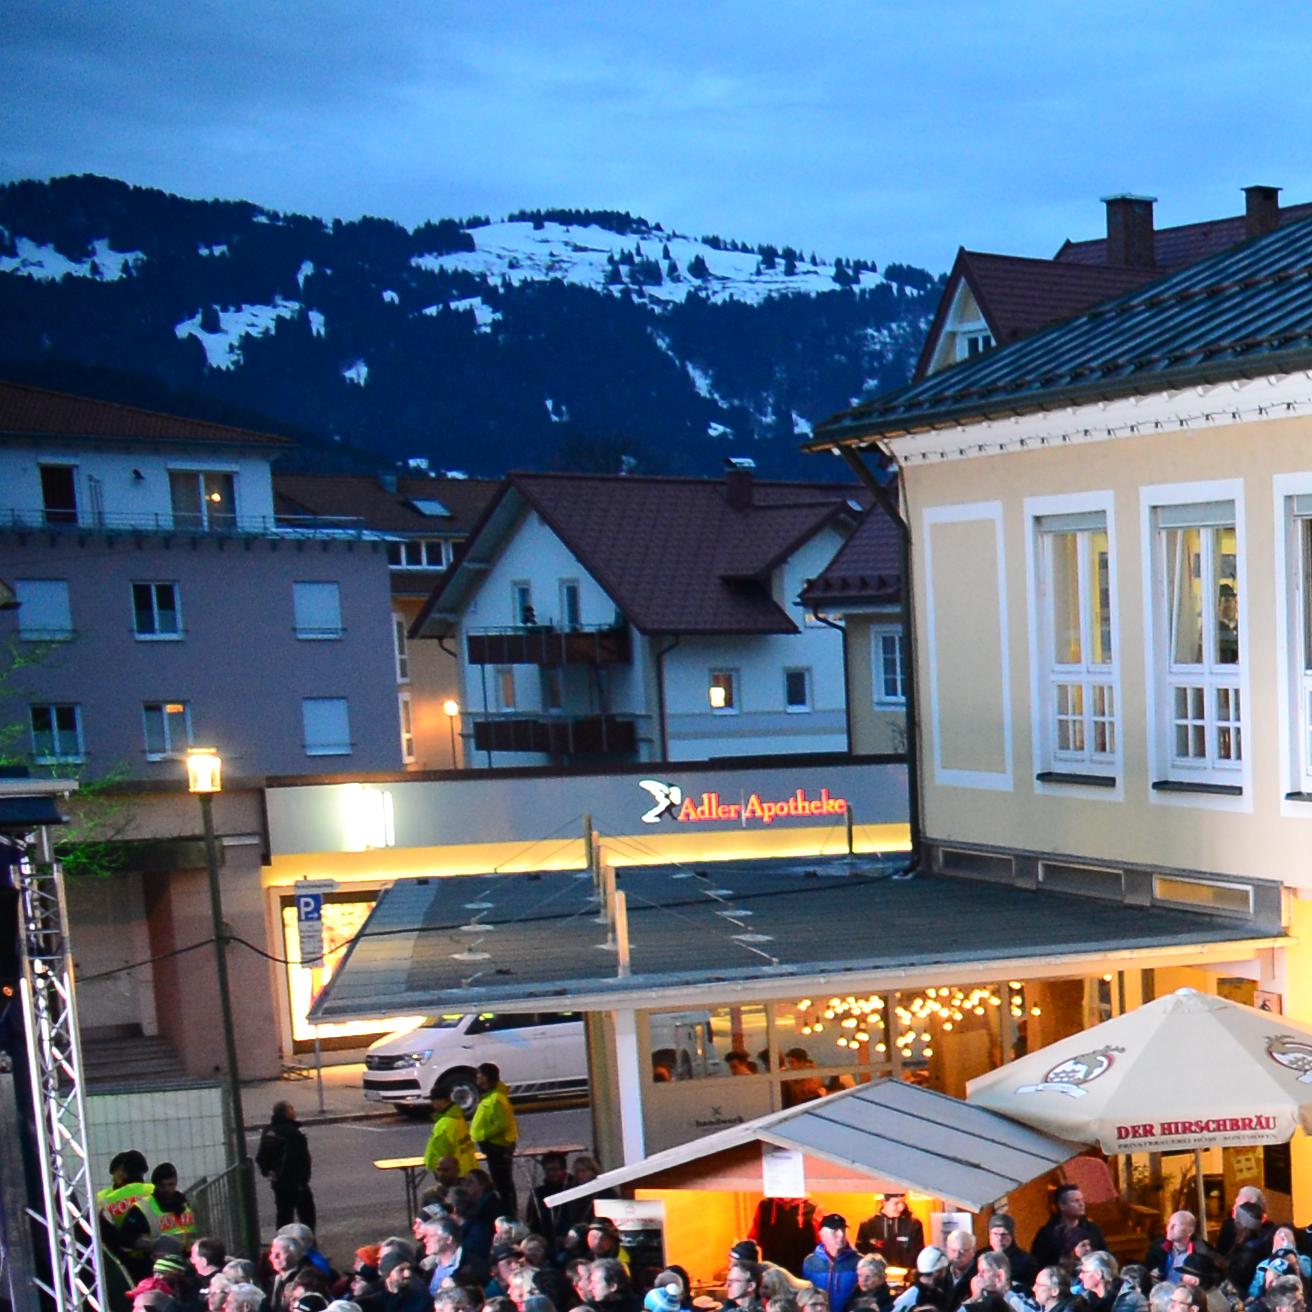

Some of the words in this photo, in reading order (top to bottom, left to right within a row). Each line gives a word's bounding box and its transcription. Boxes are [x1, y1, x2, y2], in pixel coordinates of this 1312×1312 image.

[678, 793, 743, 822] Adler
[743, 788, 847, 824] Apotheke
[300, 897, 315, 920] P
[1116, 1123, 1156, 1140] DER
[1160, 1115, 1278, 1136] HIRSCHBRÄU
